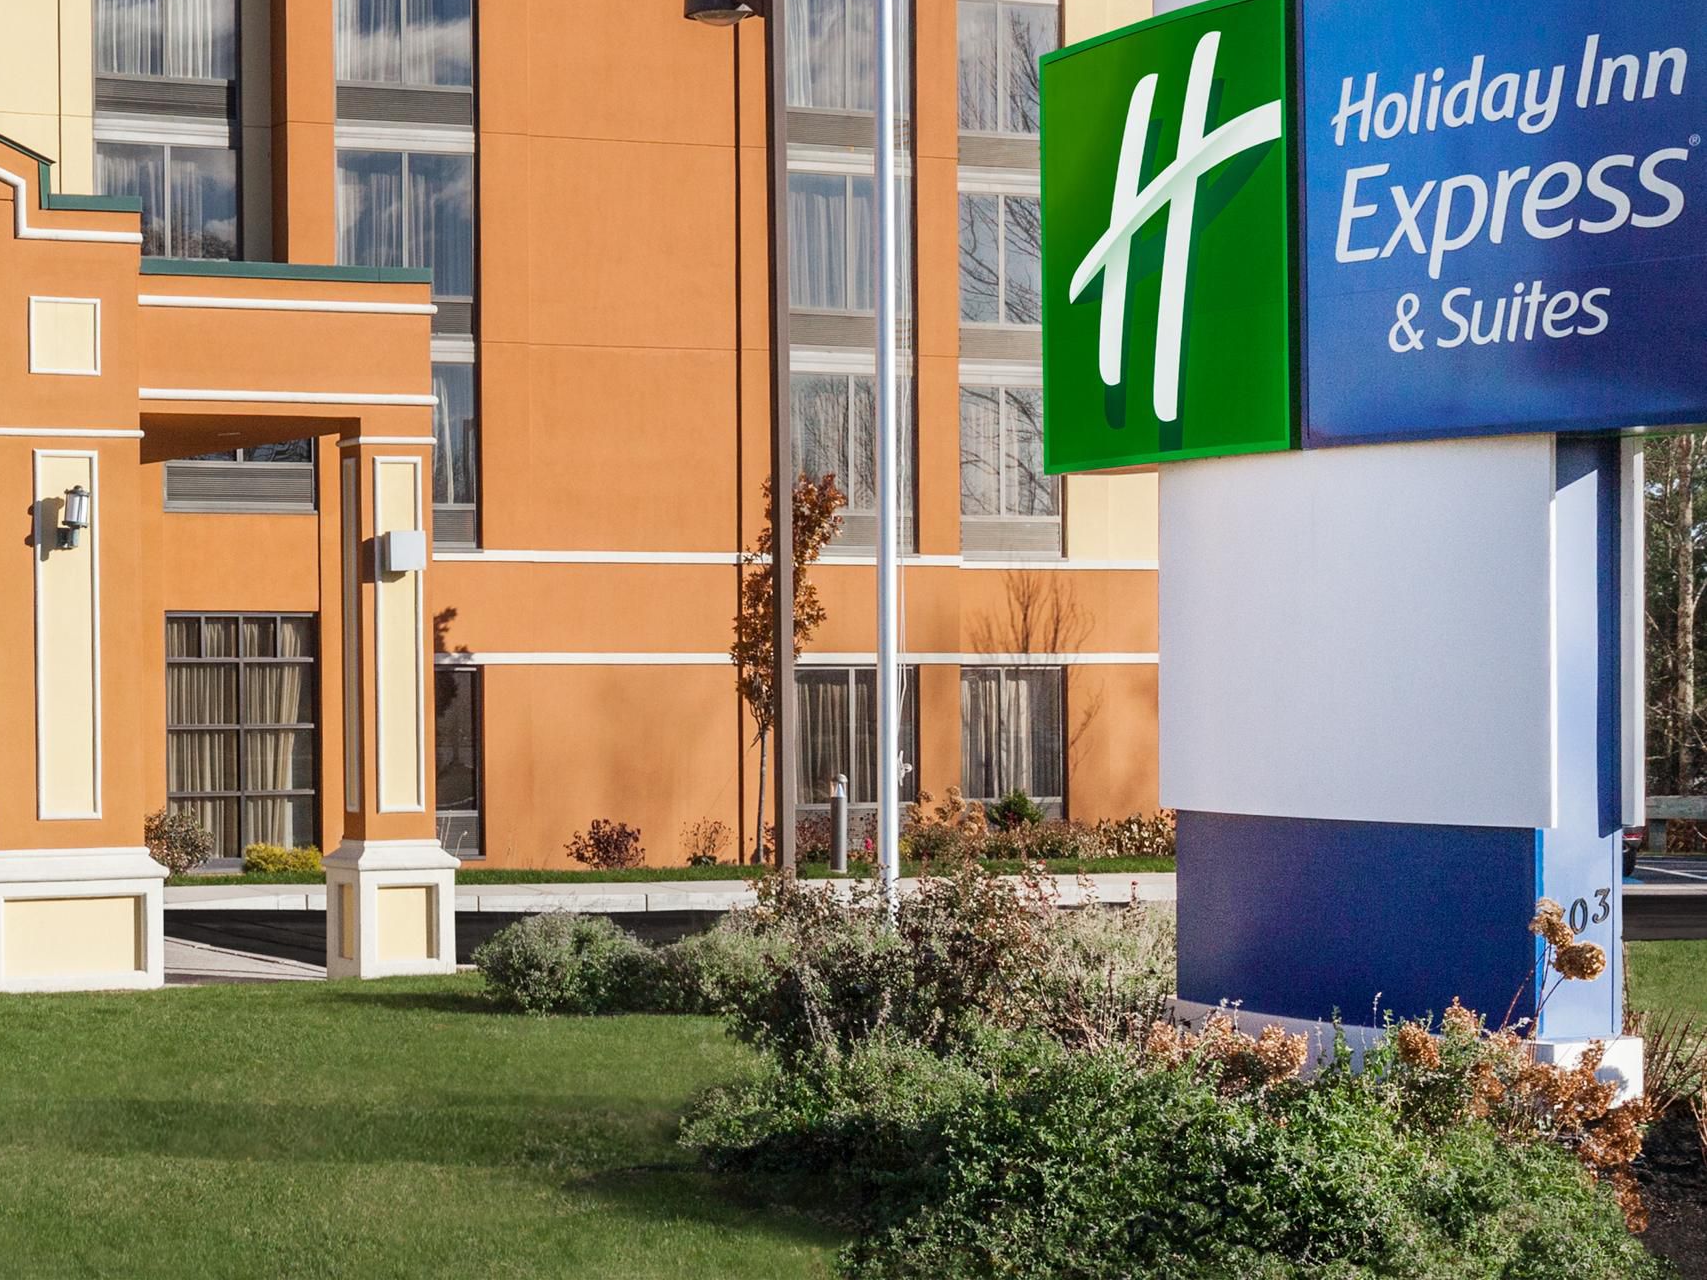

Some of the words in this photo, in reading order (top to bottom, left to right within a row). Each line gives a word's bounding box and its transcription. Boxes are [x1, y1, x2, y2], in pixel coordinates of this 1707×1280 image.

[1331, 53, 1565, 146] Holiday
[1575, 33, 1687, 108] Inn
[1334, 146, 1690, 280] Express
[1387, 292, 1426, 353] &
[1435, 279, 1611, 348] Suites
[1558, 887, 1611, 936] 03
